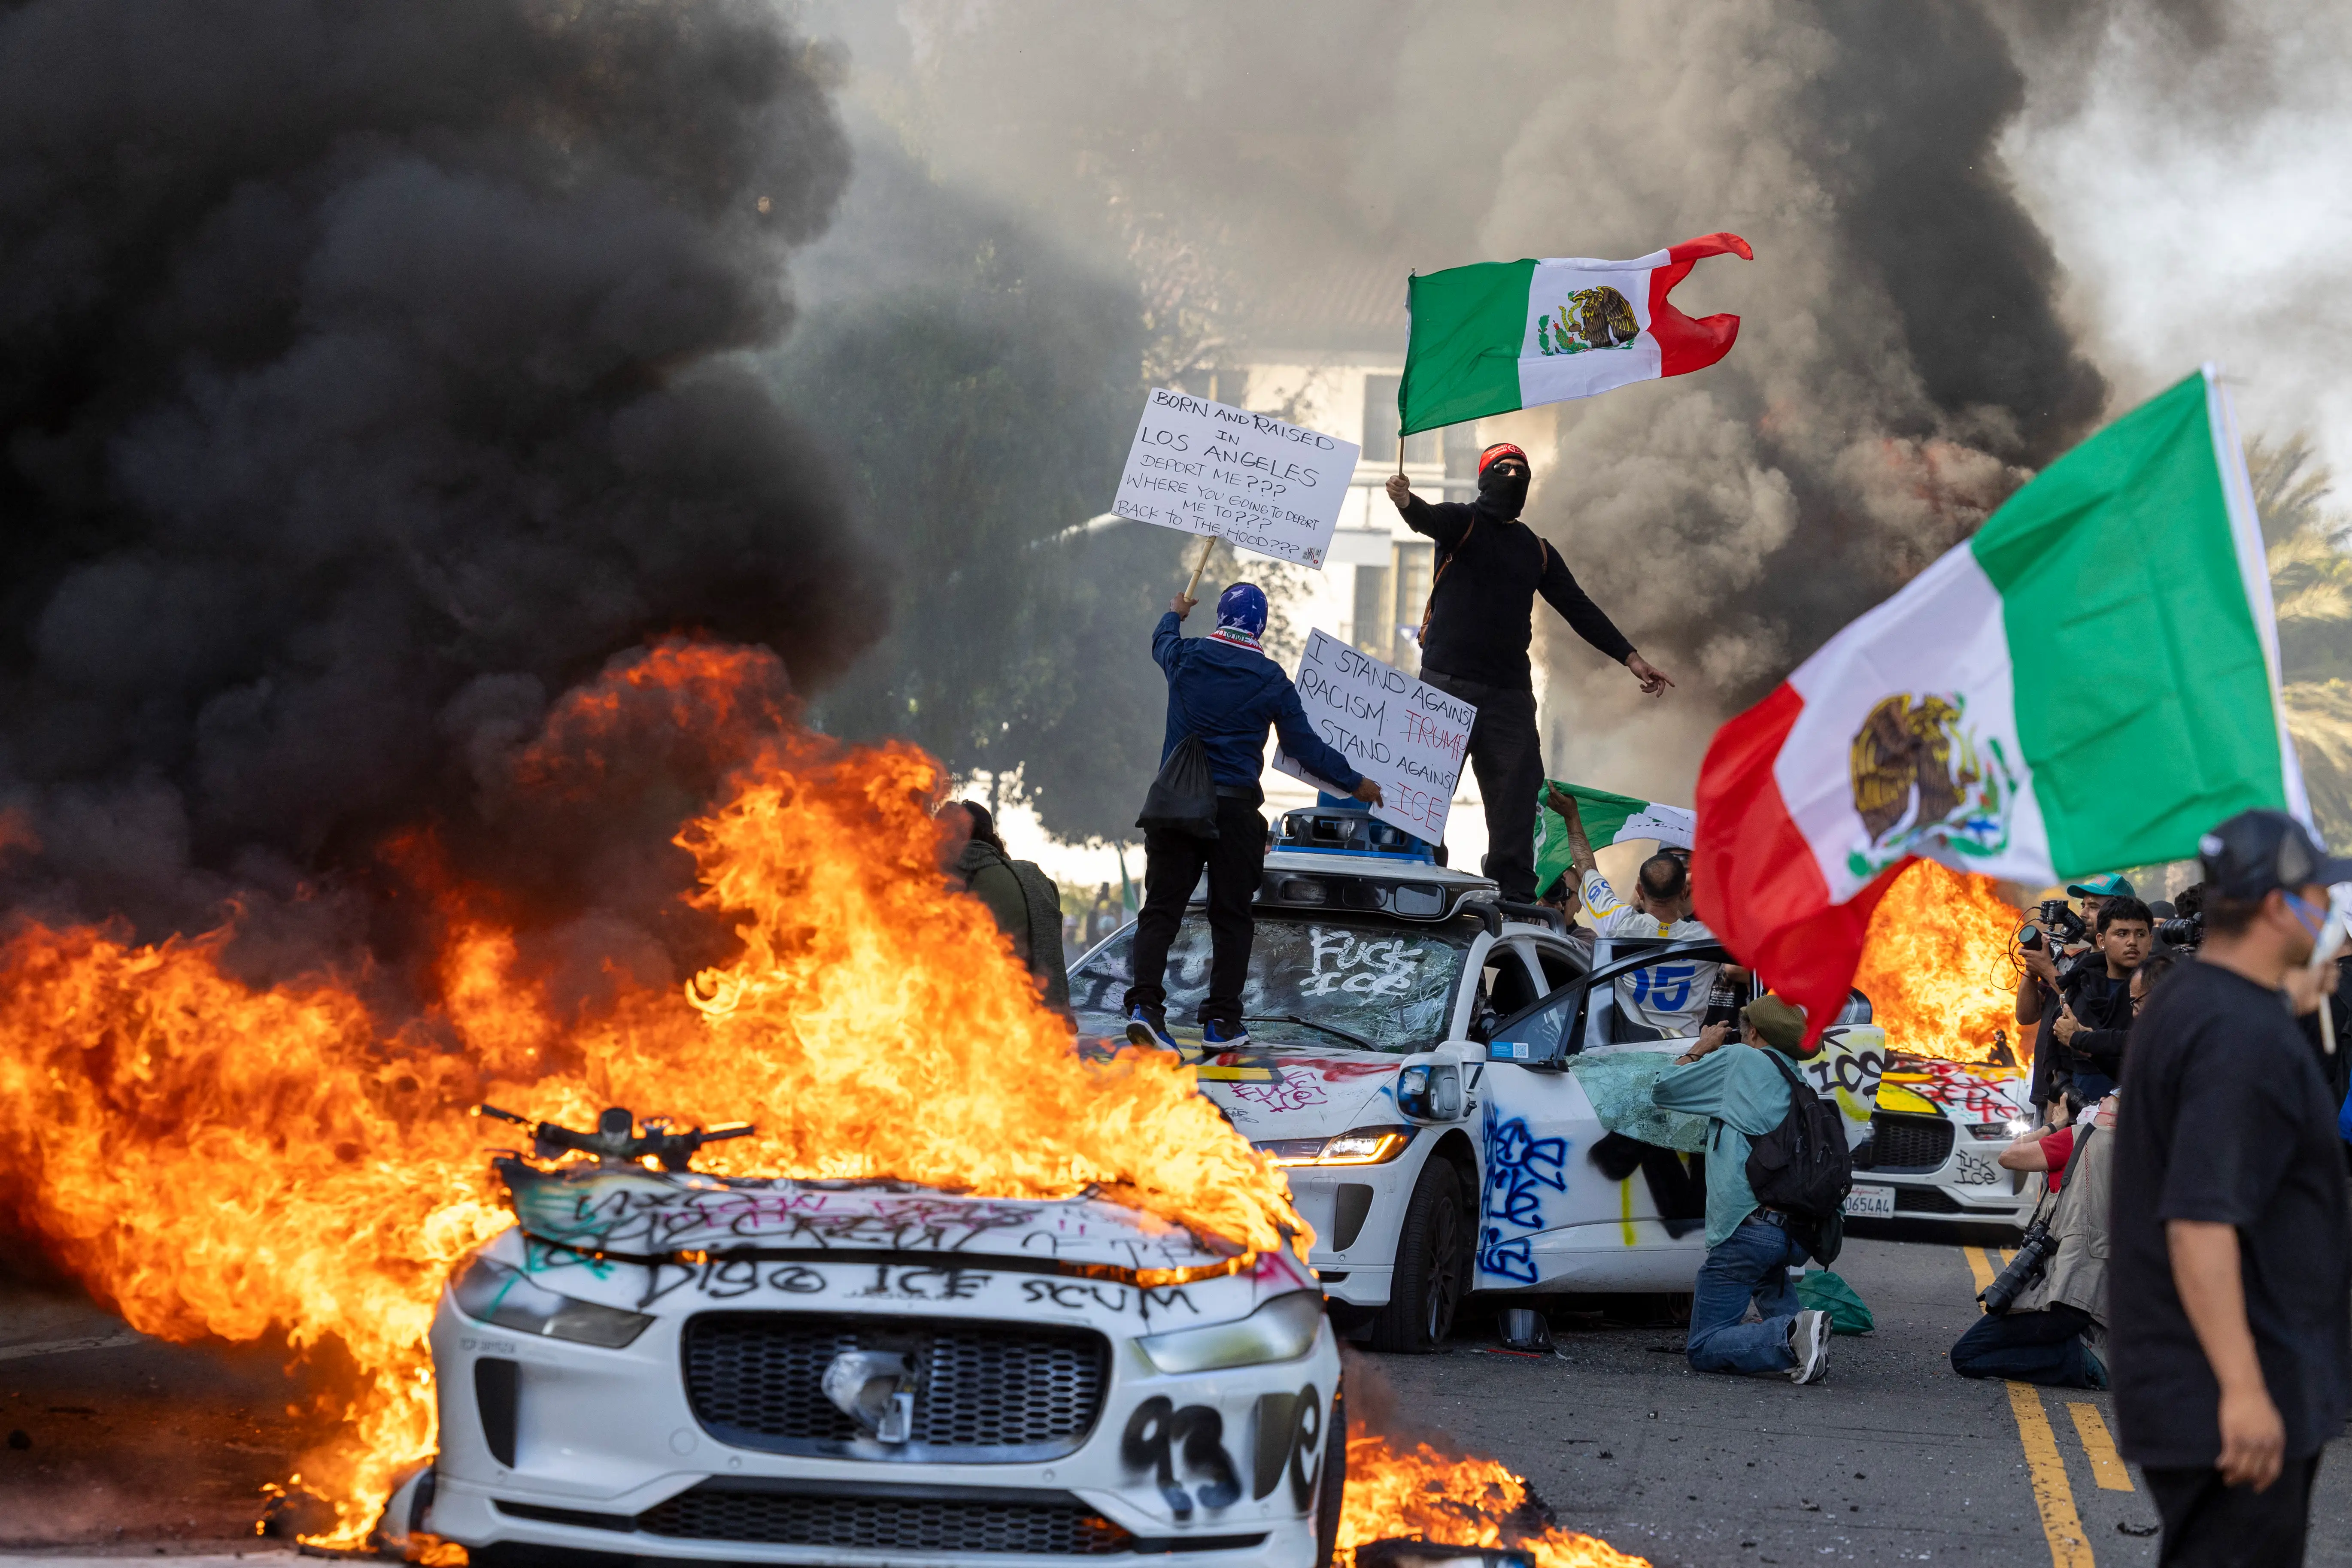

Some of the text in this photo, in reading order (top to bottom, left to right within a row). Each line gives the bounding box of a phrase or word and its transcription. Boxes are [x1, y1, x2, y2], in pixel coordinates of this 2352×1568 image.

[1153, 392, 1334, 450] BORN AND RAISED
[1215, 430, 1239, 446] IN
[1140, 455, 1286, 501] DEPORT ME???
[1141, 427, 1320, 487] LOS ANGELES
[1127, 473, 1320, 531] WHERE YOU GOING TO DEPORT
[1183, 500, 1272, 532] ME TO???
[1114, 500, 1159, 519] BACK
[1193, 516, 1220, 533] THE
[1227, 527, 1300, 558] HOOD???
[1308, 633, 1477, 732] I STAND AGAINST
[1321, 719, 1390, 764] STAND
[1406, 710, 1467, 761] TRUMP
[1390, 782, 1442, 833] ICE
